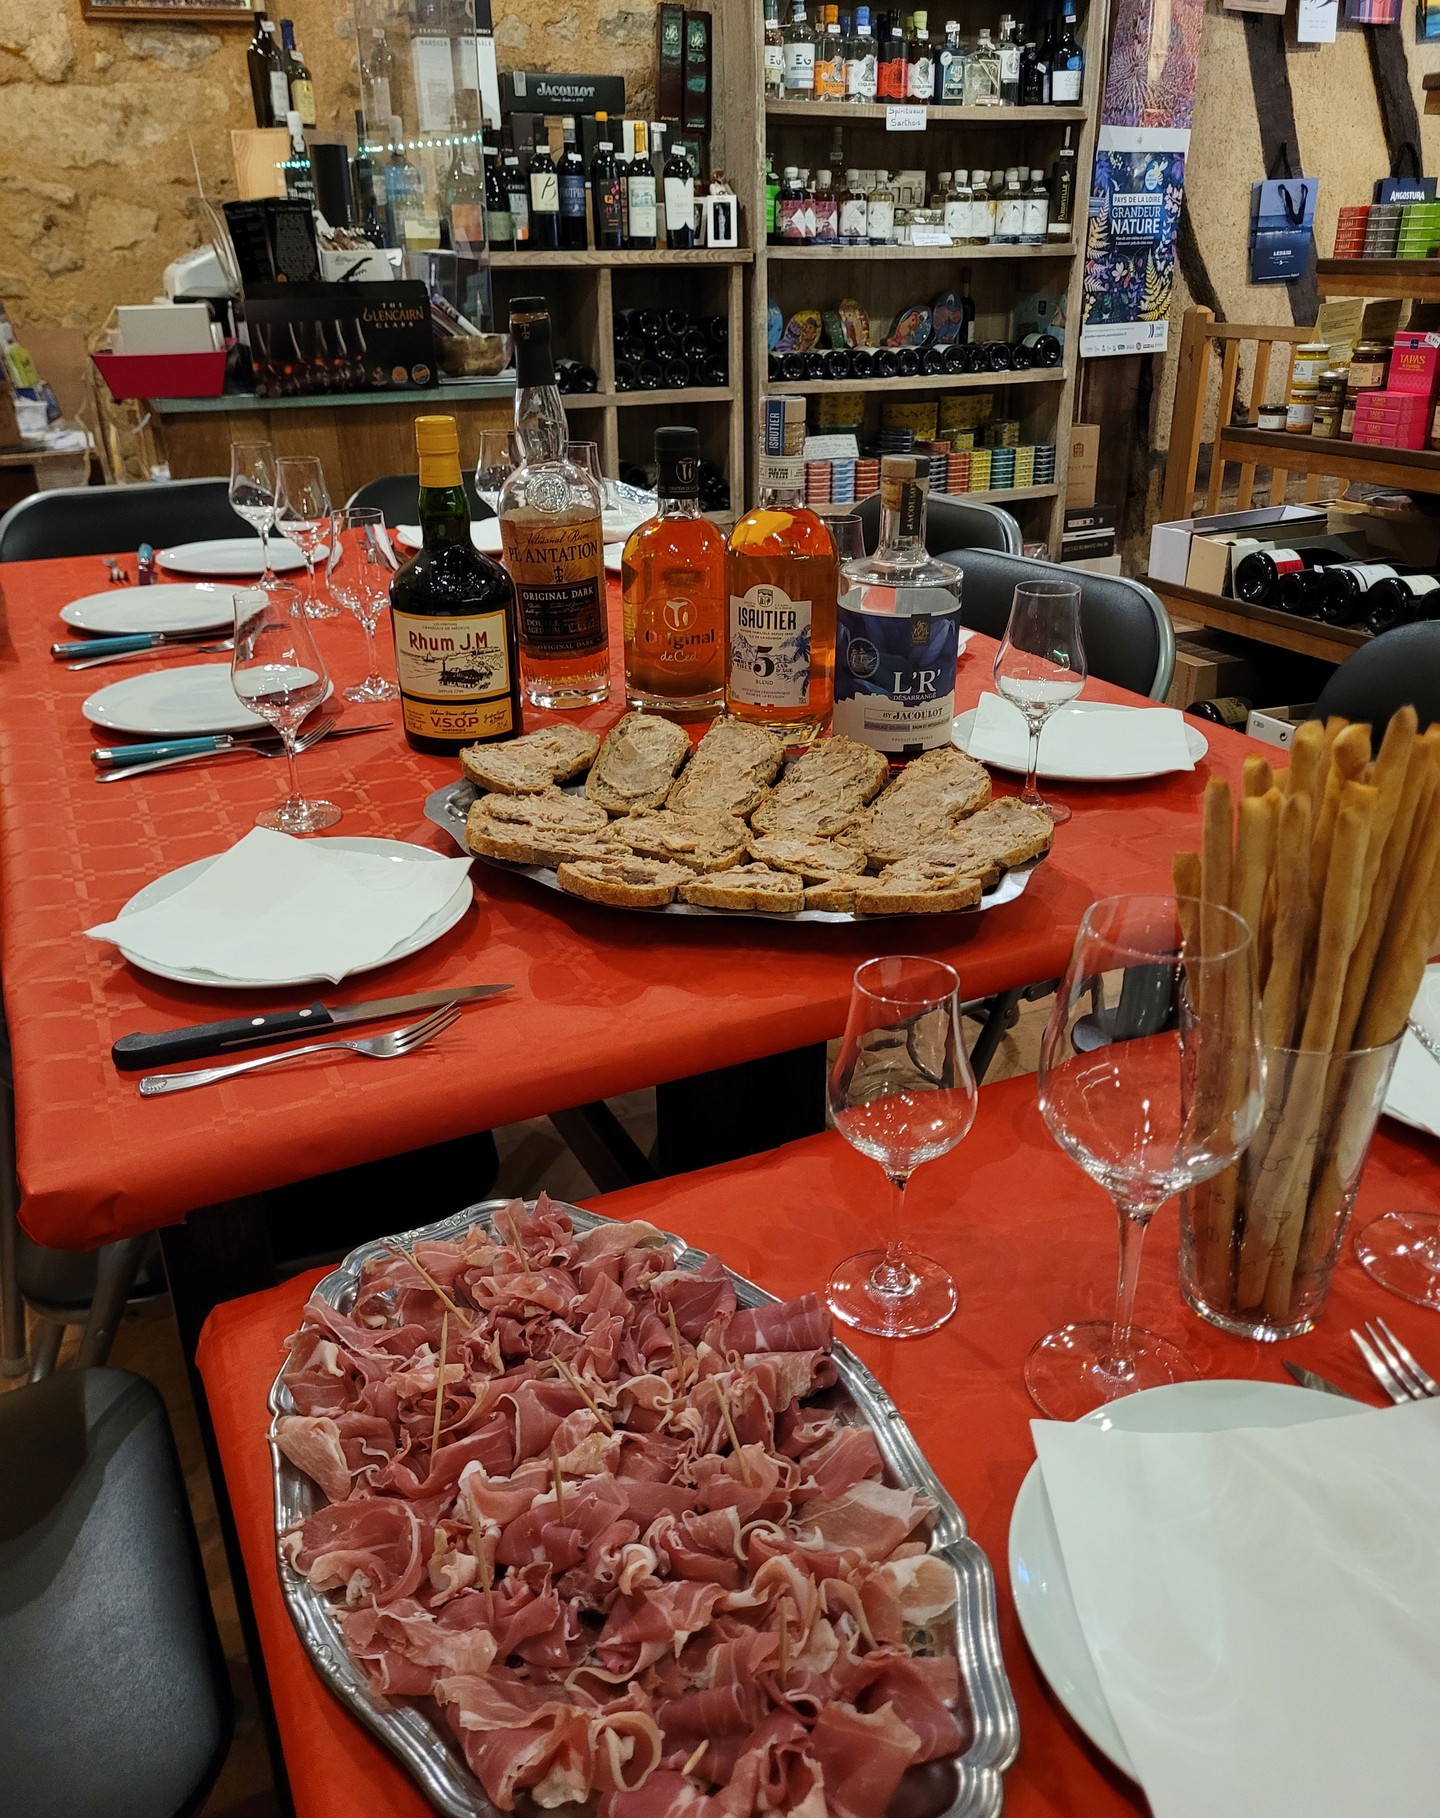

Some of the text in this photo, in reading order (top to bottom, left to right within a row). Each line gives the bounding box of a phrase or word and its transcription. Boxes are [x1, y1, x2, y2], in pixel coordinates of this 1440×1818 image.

[536, 82, 595, 97] JACOULOT
[888, 107, 924, 117] Spiritueux
[1390, 191, 1425, 201] ANGOSTURA
[1112, 206, 1161, 218] GRANDEUR
[1111, 218, 1161, 235] NATURE
[363, 305, 424, 322] GLENCAIRN
[1400, 354, 1426, 365] TAPAS
[769, 412, 780, 449] ISAUTIER
[508, 540, 598, 563] PLANTATION
[522, 586, 594, 601] ORIGINAL DARK
[738, 606, 797, 630] ISAUTIER
[409, 630, 488, 651] Rhum J.M
[537, 640, 594, 650] ORIGINAL DARK
[753, 645, 775, 678] 5
[892, 707, 943, 720] JACOULOT
[430, 716, 479, 728] V.S.O.P
